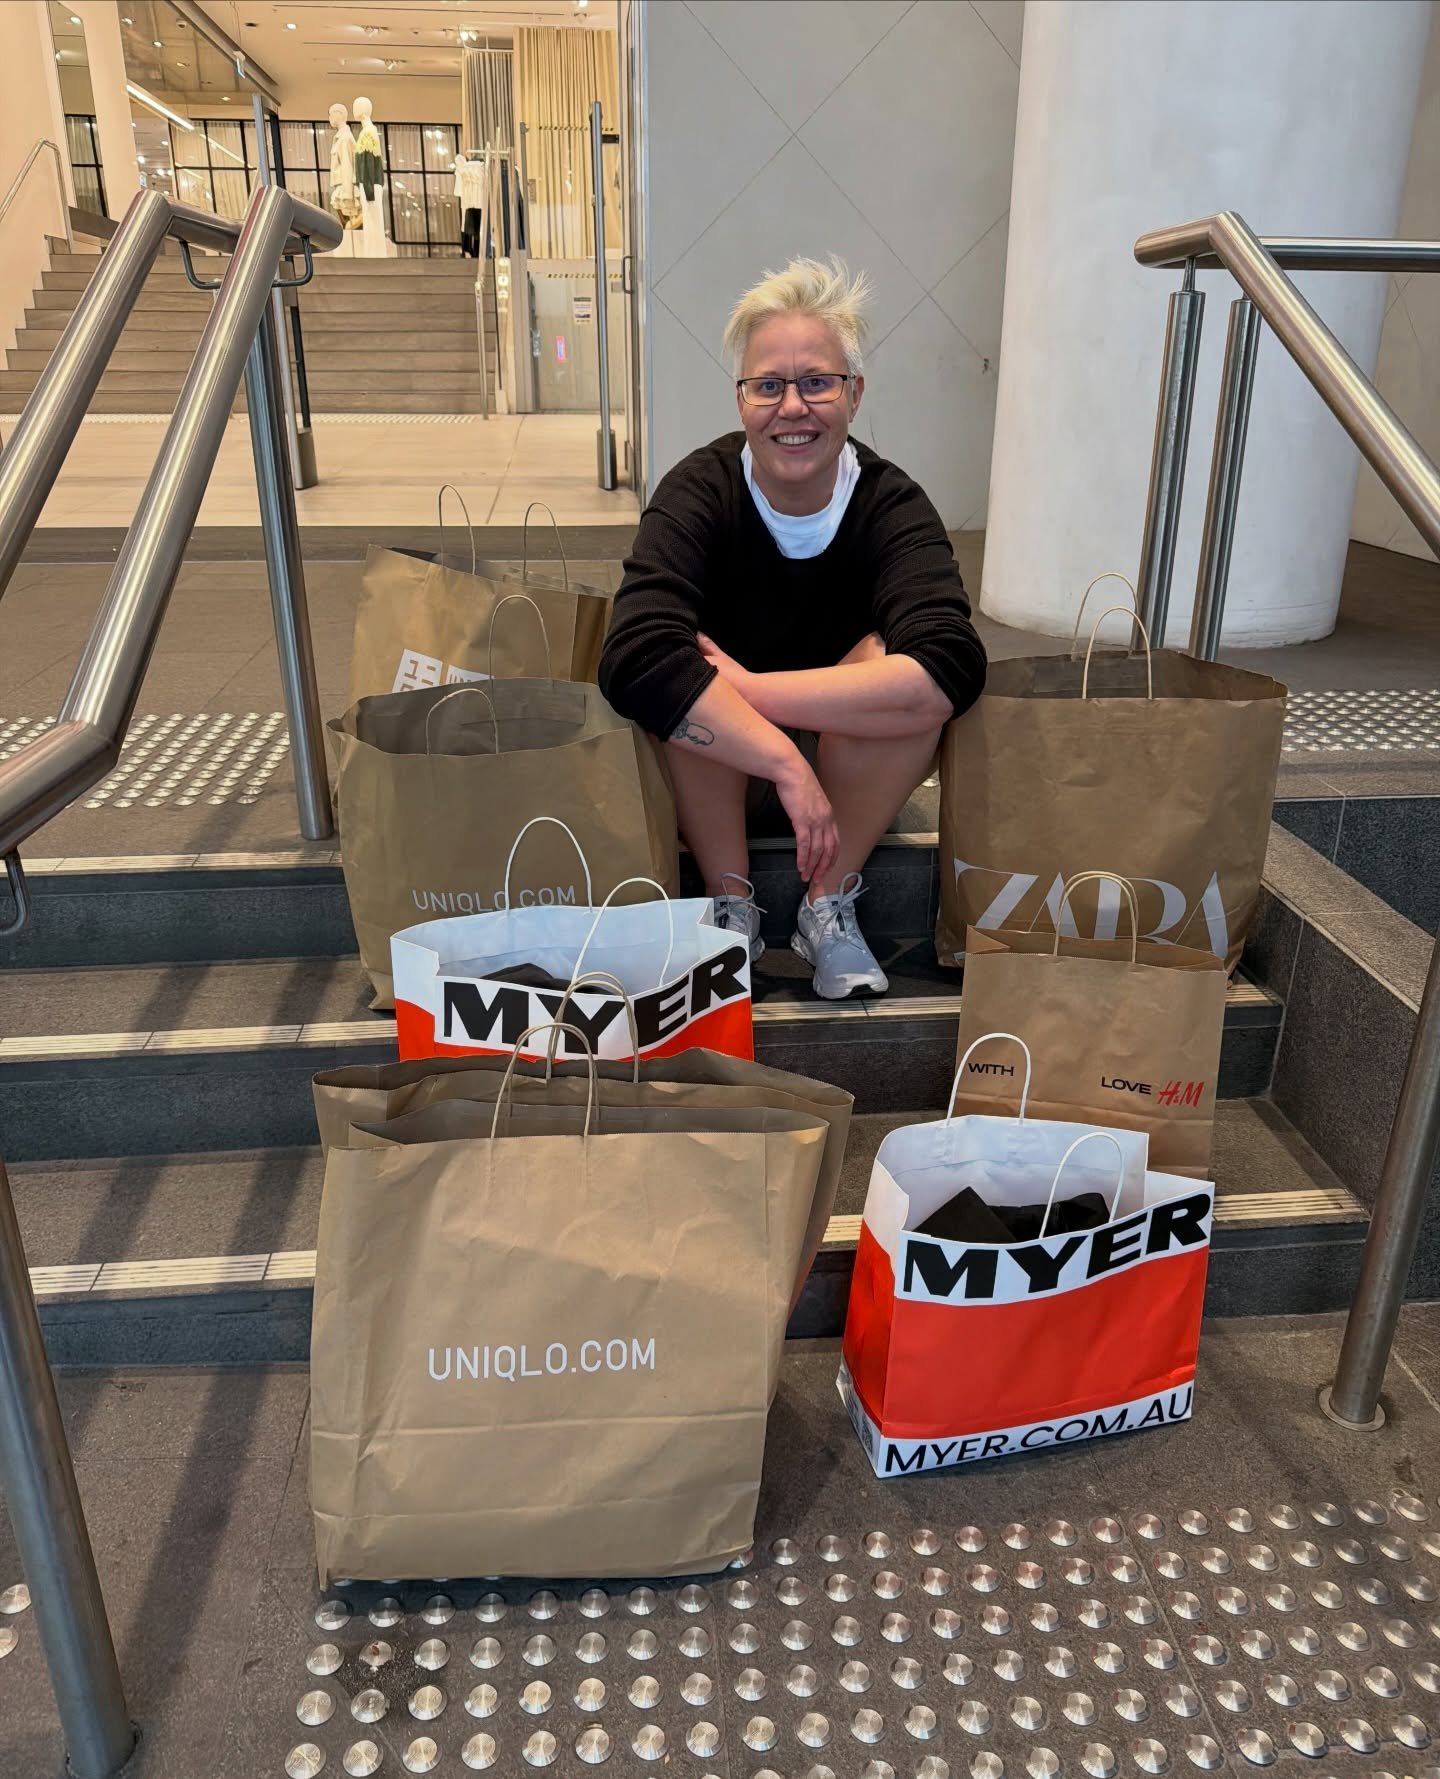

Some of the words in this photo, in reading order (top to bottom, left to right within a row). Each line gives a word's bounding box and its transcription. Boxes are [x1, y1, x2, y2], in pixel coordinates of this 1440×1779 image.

[954, 857, 1229, 960] ZARA
[443, 945, 748, 1055] MYER
[968, 1062, 1015, 1077] WITH
[1101, 1076, 1152, 1095] LOVE
[1157, 1080, 1204, 1107] H&M
[903, 1194, 1211, 1299] MYER
[428, 1338, 656, 1381] UNIQLO.COM
[885, 1387, 1192, 1473] MYER.COM.AU
